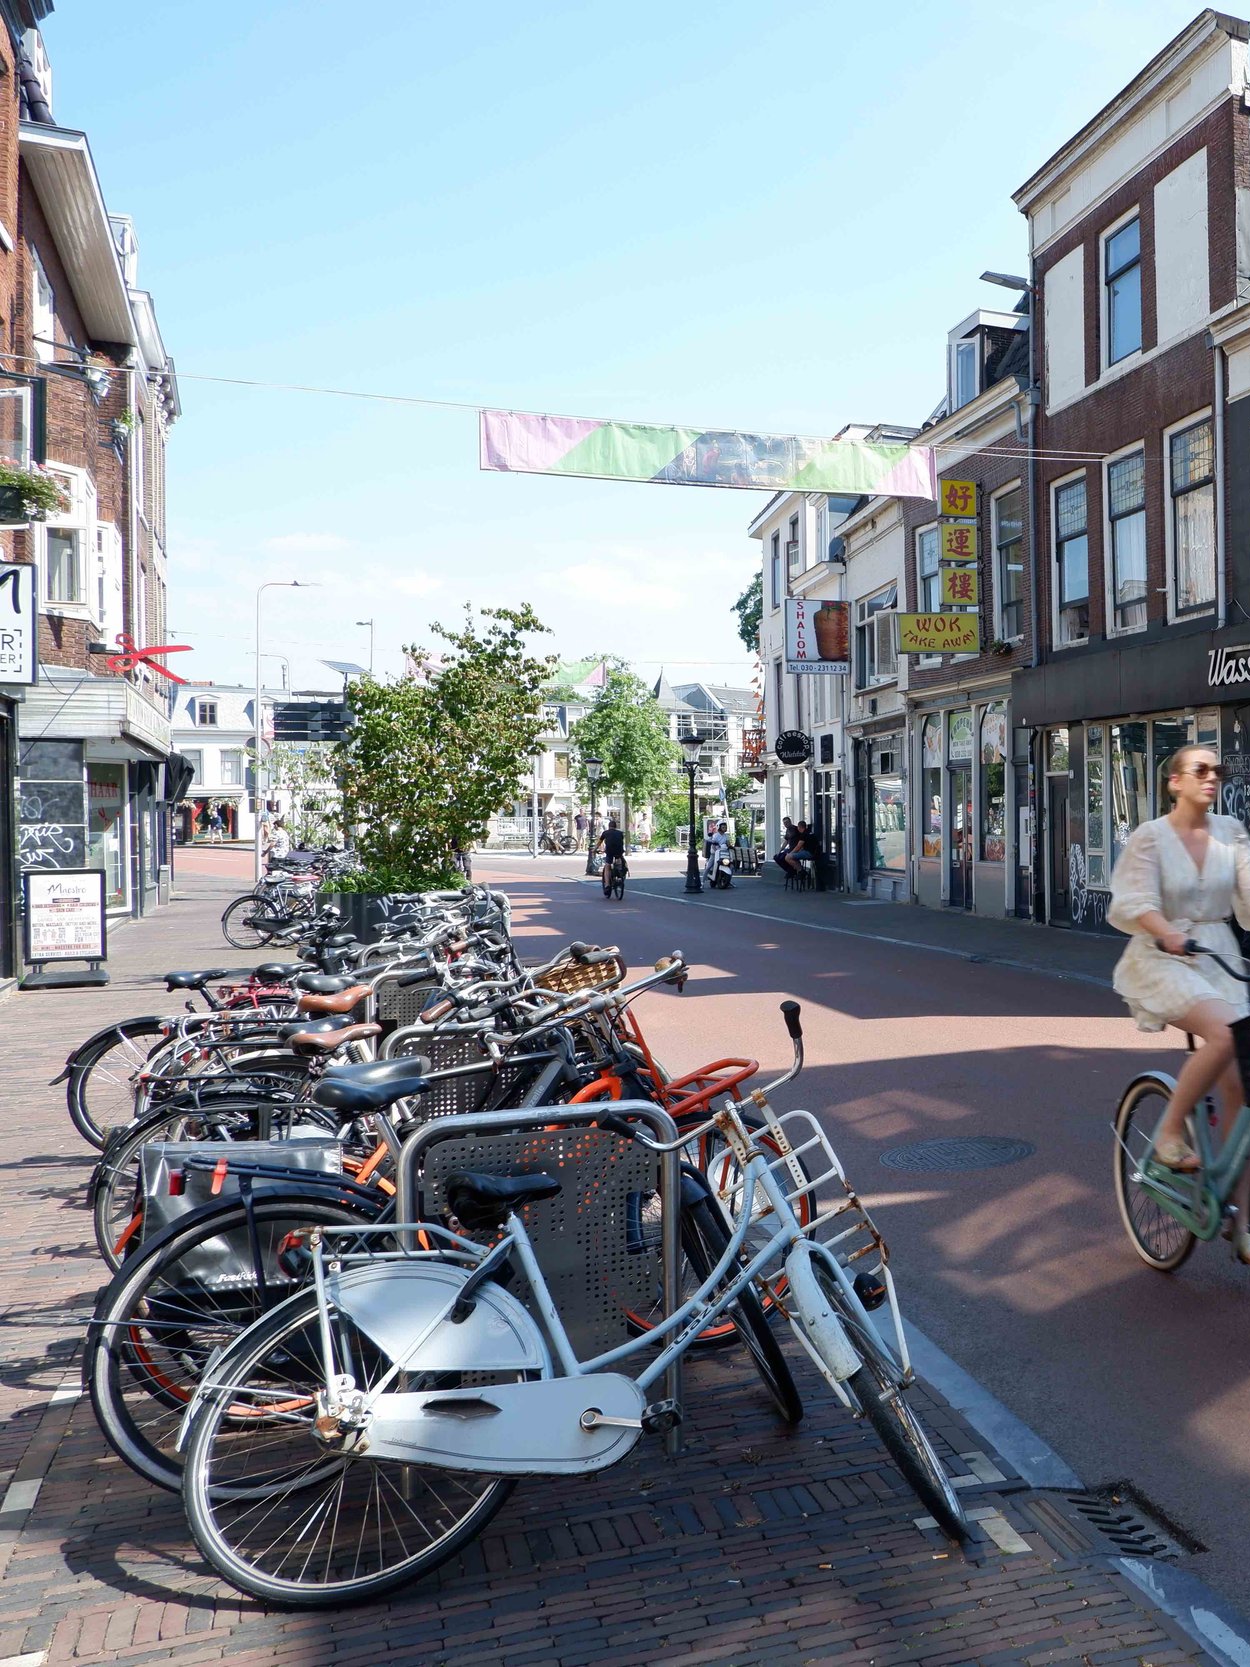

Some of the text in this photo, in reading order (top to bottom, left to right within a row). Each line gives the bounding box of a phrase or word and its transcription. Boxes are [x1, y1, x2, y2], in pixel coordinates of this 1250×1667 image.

[945, 484, 975, 601] 好運樓
[796, 602, 807, 659] SHALOM
[916, 617, 961, 632] WOK
[903, 629, 976, 648] TAKE AWAY
[777, 731, 809, 750] coffeeshop
[47, 883, 86, 895] Maestro
